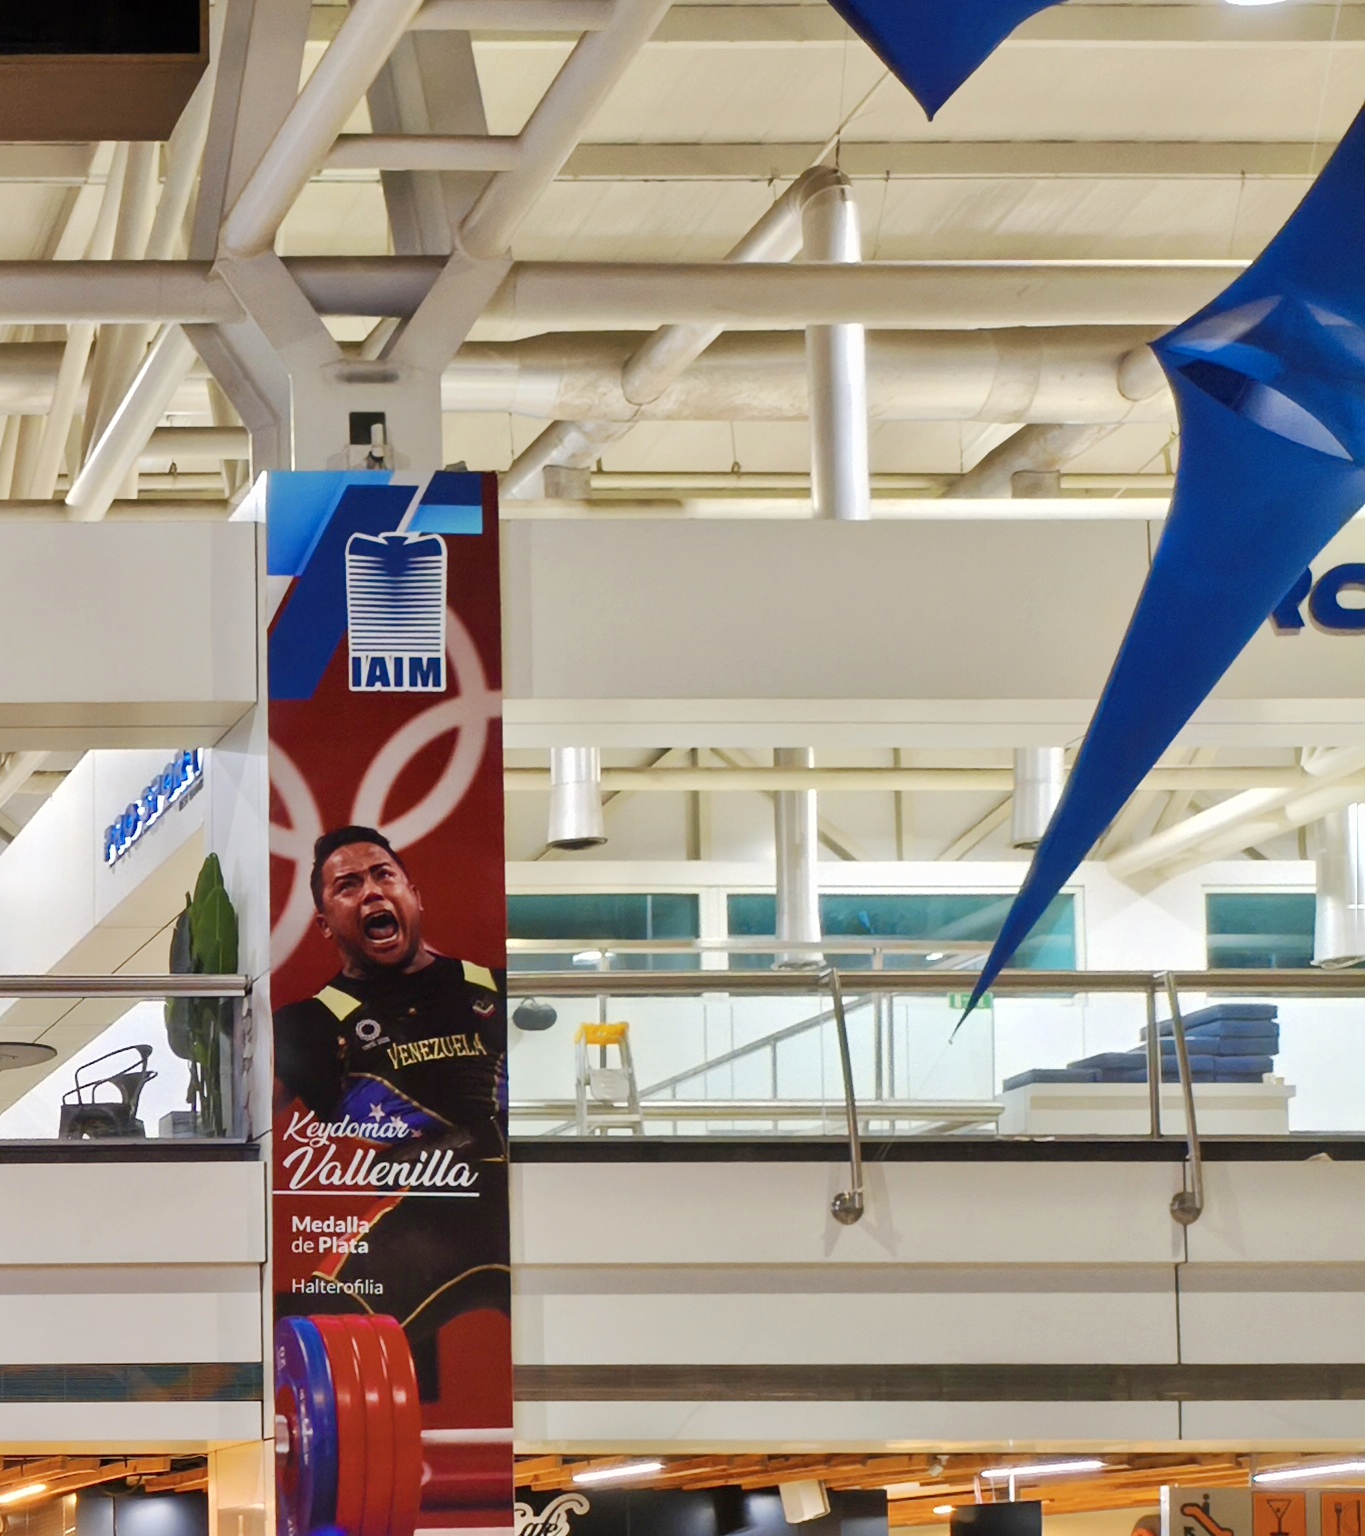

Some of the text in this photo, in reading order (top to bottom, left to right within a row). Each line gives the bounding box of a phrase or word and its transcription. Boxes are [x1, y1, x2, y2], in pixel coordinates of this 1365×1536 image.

[351, 656, 442, 688] IAIM
[386, 1032, 488, 1070] VENEZUELA
[282, 1110, 410, 1148] Keydomar
[282, 1145, 479, 1190] Vallenilla
[291, 1216, 370, 1233] Medalla
[291, 1236, 370, 1254] de Plata
[291, 1278, 384, 1296] Halterofilia
